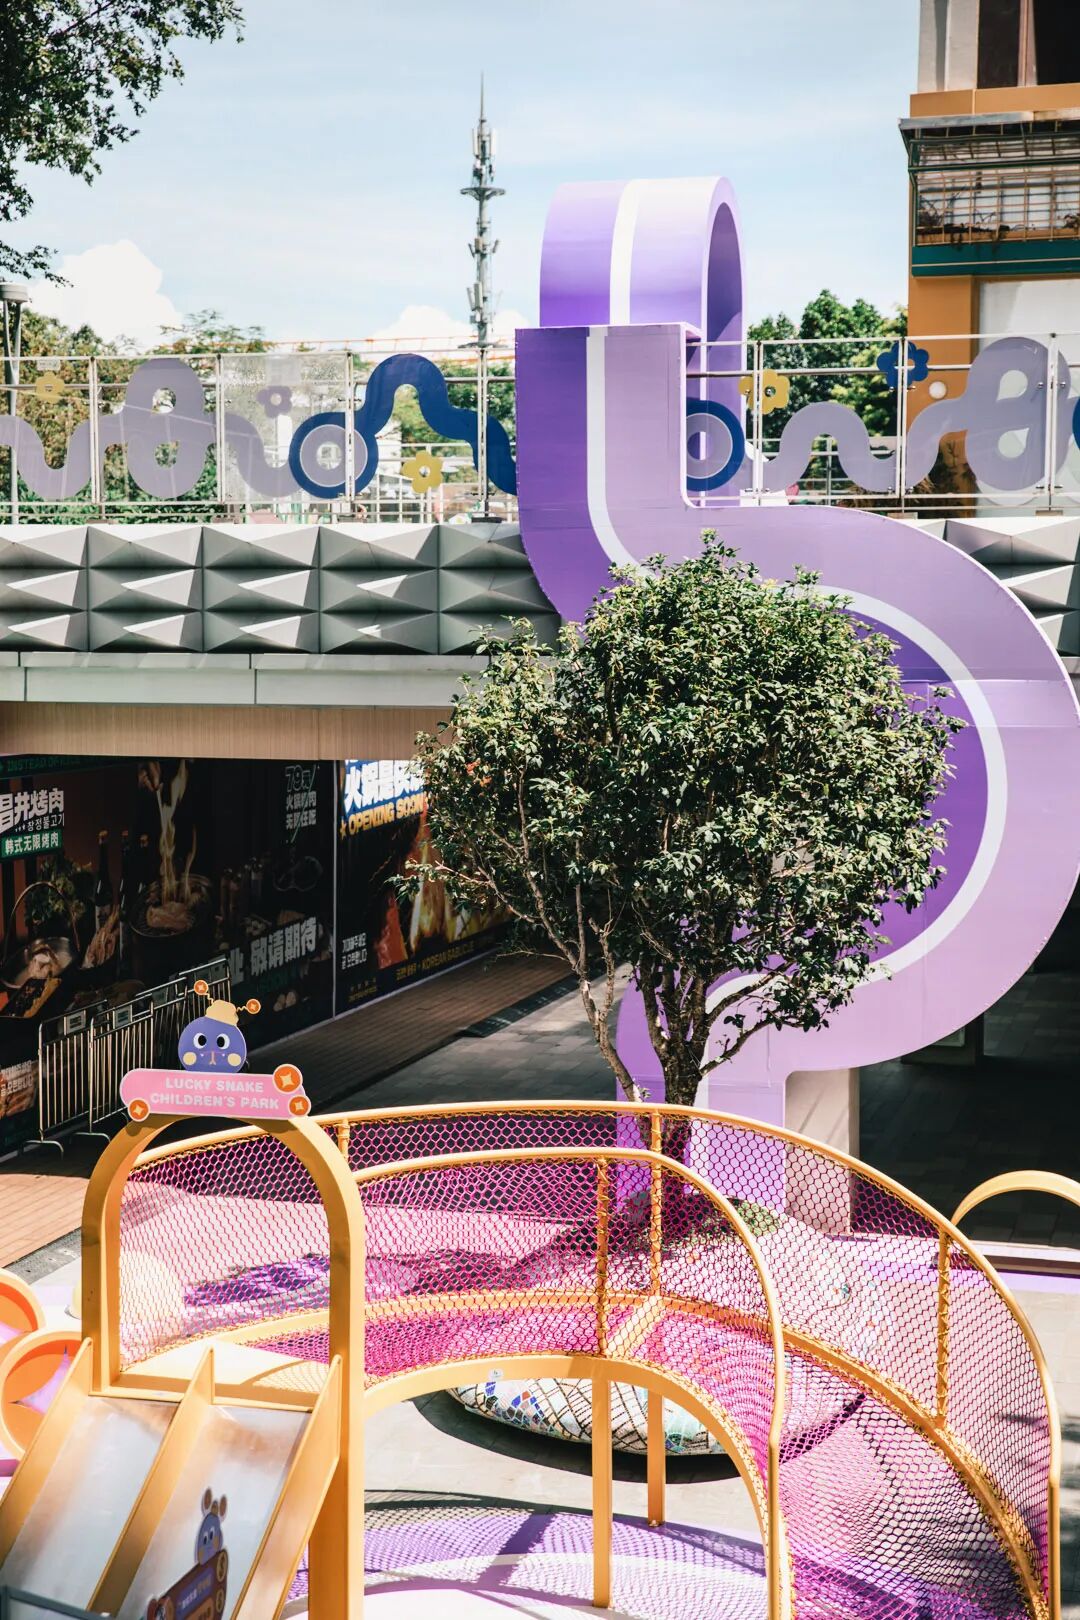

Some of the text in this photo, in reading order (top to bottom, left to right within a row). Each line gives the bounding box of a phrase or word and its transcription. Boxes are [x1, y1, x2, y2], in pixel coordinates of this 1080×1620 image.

[348, 793, 425, 836] OPENING SOON
[5, 832, 59, 855] 韩式无限烤肉
[165, 1077, 264, 1092] LUCKY SNAKE
[150, 1093, 279, 1109] CHILDREN'S PARK
